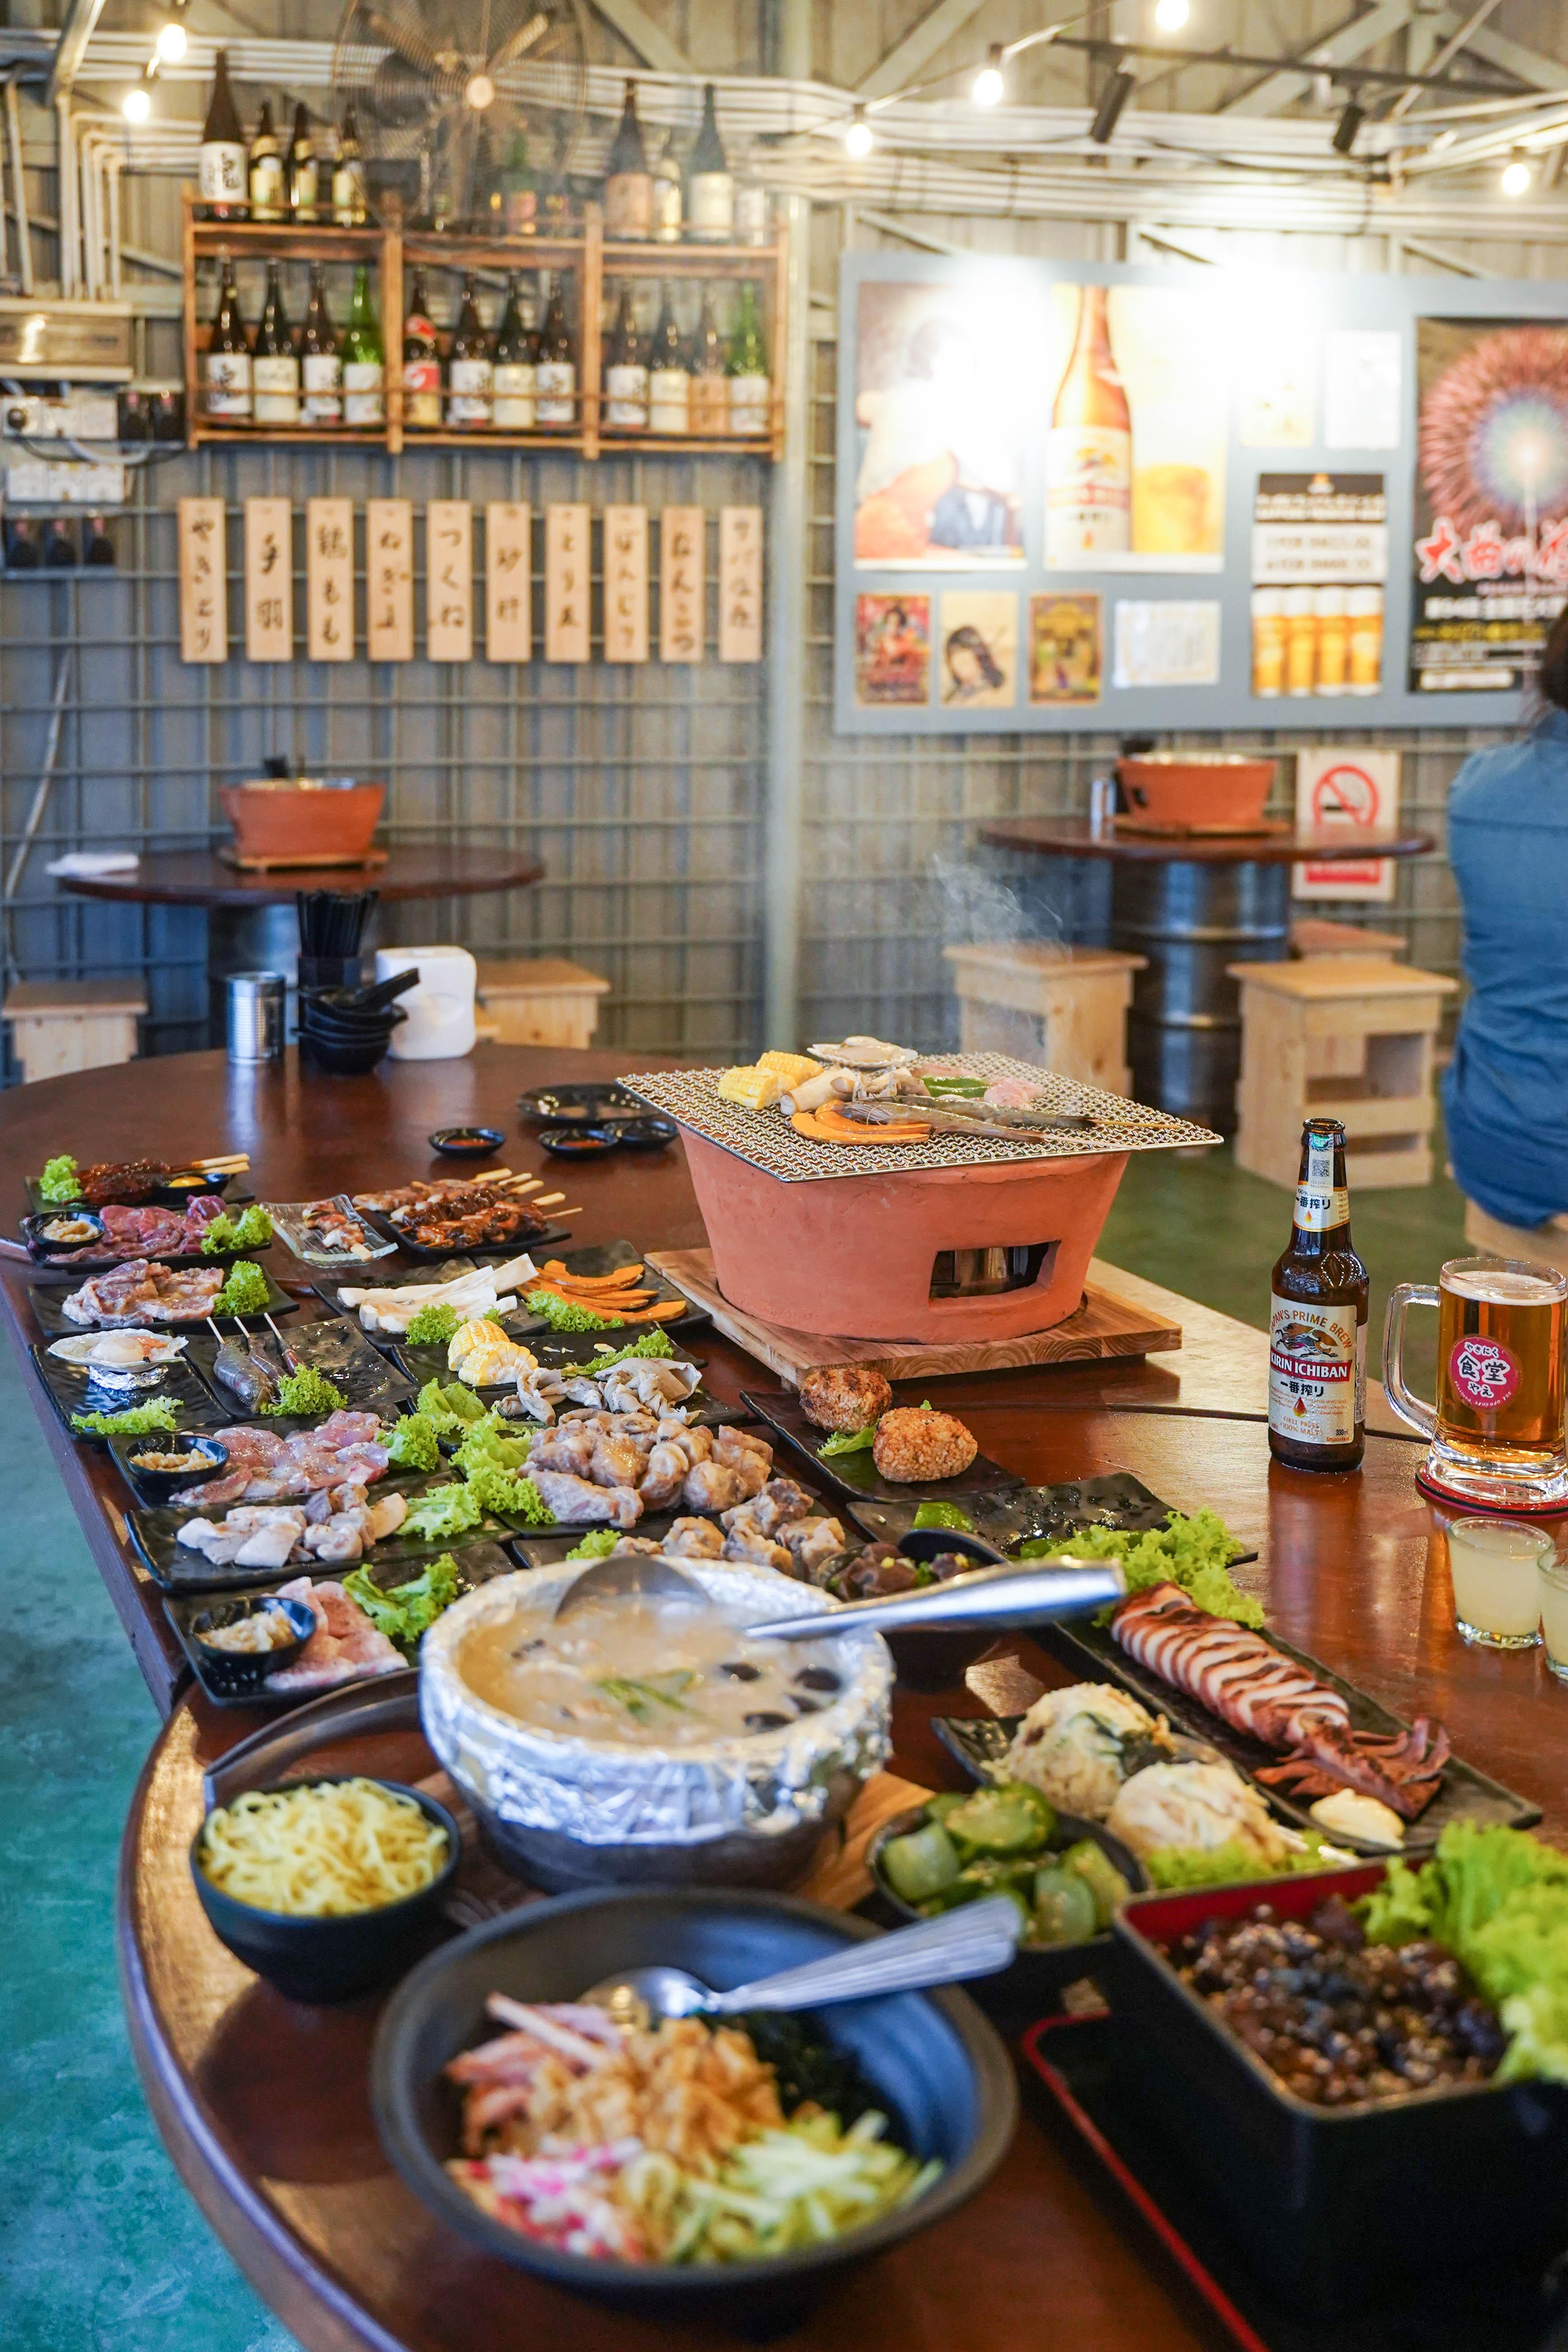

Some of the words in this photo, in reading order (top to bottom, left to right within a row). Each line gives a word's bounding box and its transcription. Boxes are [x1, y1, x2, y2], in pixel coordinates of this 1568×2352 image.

[1296, 1196, 1330, 1210] 一番搾り
[1292, 1310, 1328, 1328] PRIME
[1329, 1321, 1352, 1349] BREW
[1466, 1343, 1499, 1357] やきにく
[1271, 1350, 1292, 1372] KIRIN
[1295, 1361, 1347, 1378] ICHIBAN
[1460, 1354, 1507, 1382] 食堂
[1280, 1381, 1324, 1397] 一番搾り
[1469, 1383, 1492, 1396] やえ
